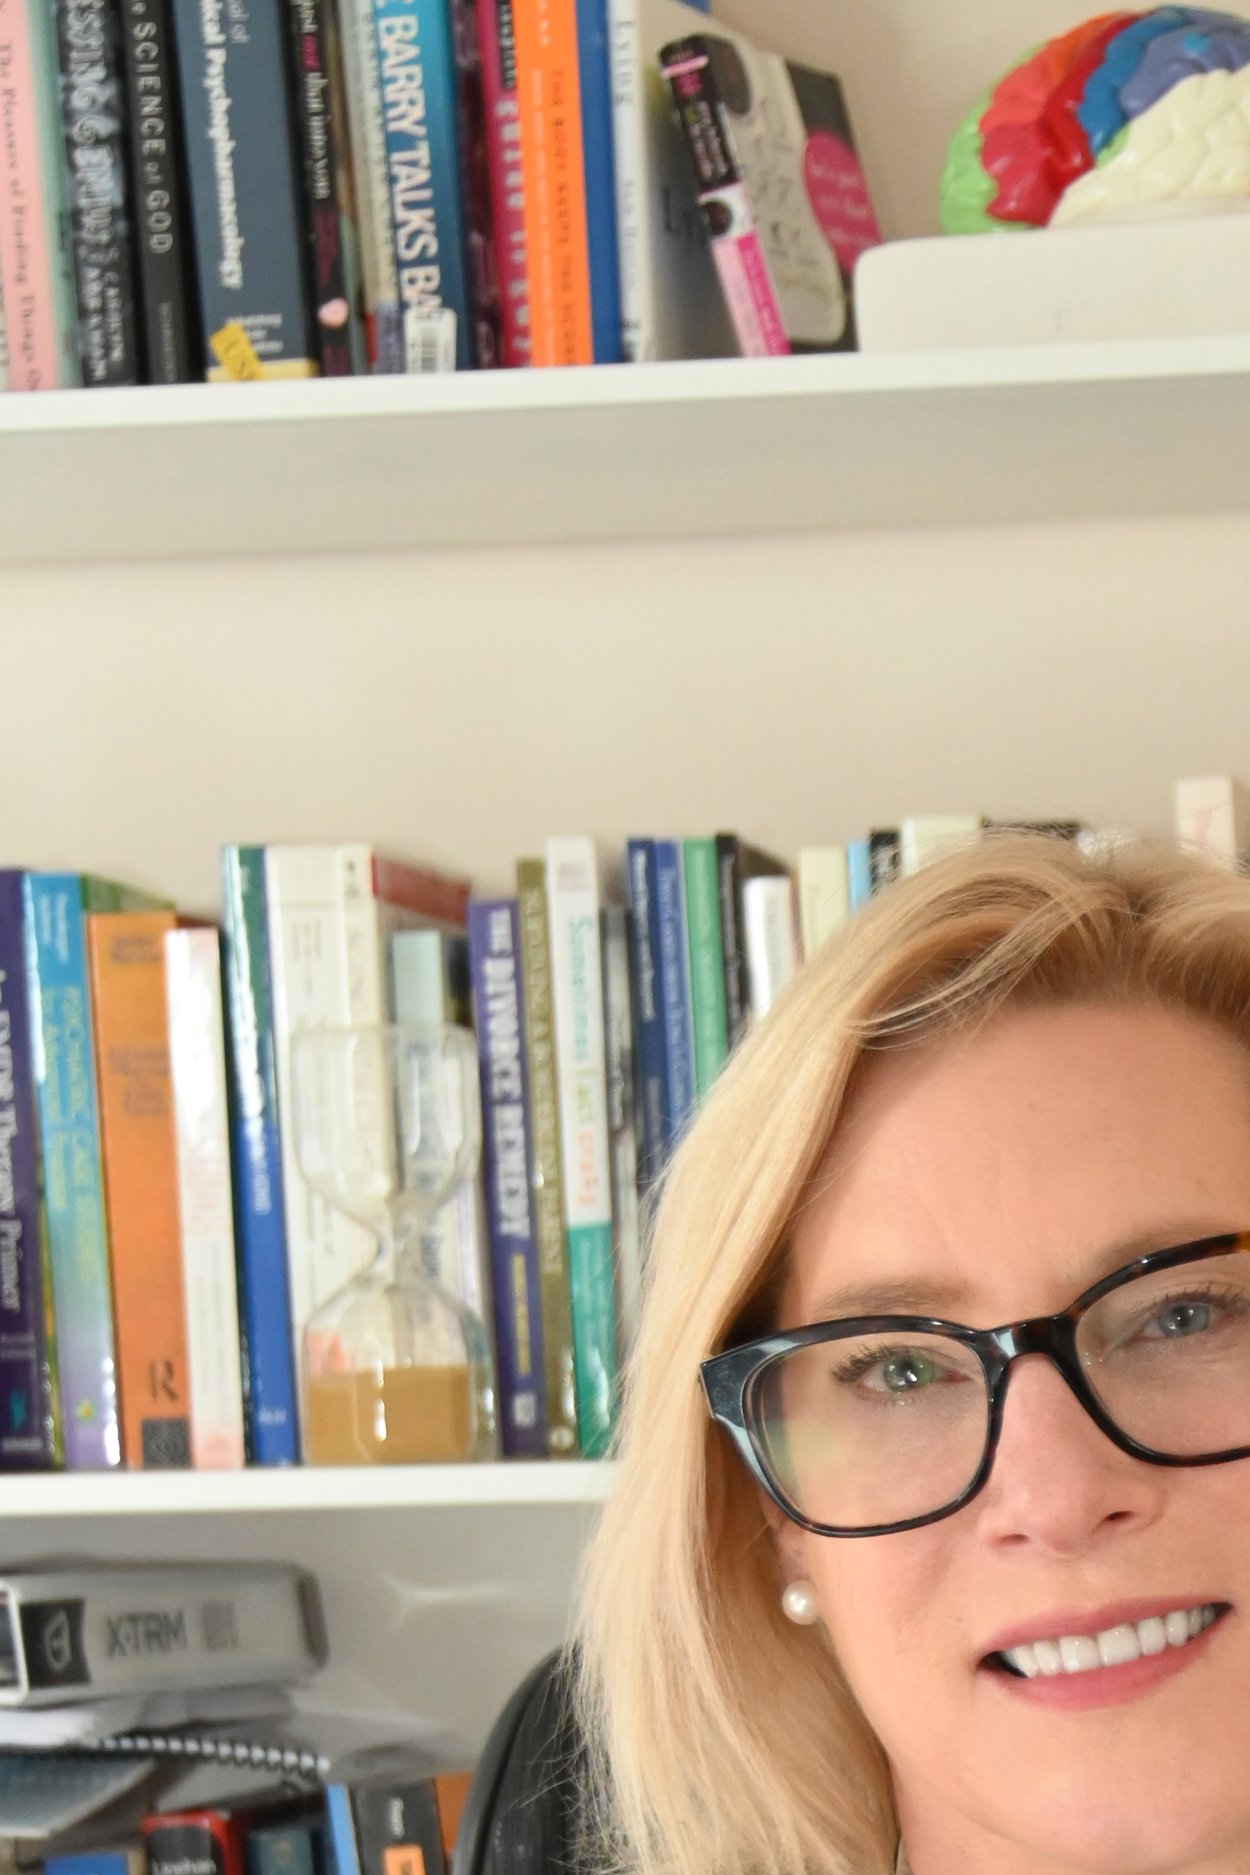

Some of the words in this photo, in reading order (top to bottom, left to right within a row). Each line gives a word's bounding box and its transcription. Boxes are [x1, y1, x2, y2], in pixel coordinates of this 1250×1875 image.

[232, 25, 251, 43] of
[377, 14, 428, 136] BARRY
[614, 19, 638, 106] Lying
[132, 22, 166, 155] SCIENCE
[11, 178, 24, 198] of
[145, 162, 161, 184] of
[201, 48, 246, 289] Psychopharmacology
[390, 142, 439, 260] TALKS
[12, 205, 30, 284] Finding
[147, 190, 173, 254] GOD
[20, 293, 40, 363] Things
[491, 908, 515, 956] THE
[483, 957, 523, 1101] DIVORCE
[568, 917, 598, 1063] Sometimes
[576, 1084, 602, 1125] act
[491, 1104, 532, 1239] REMEDY
[1, 1218, 23, 1312] Primer
